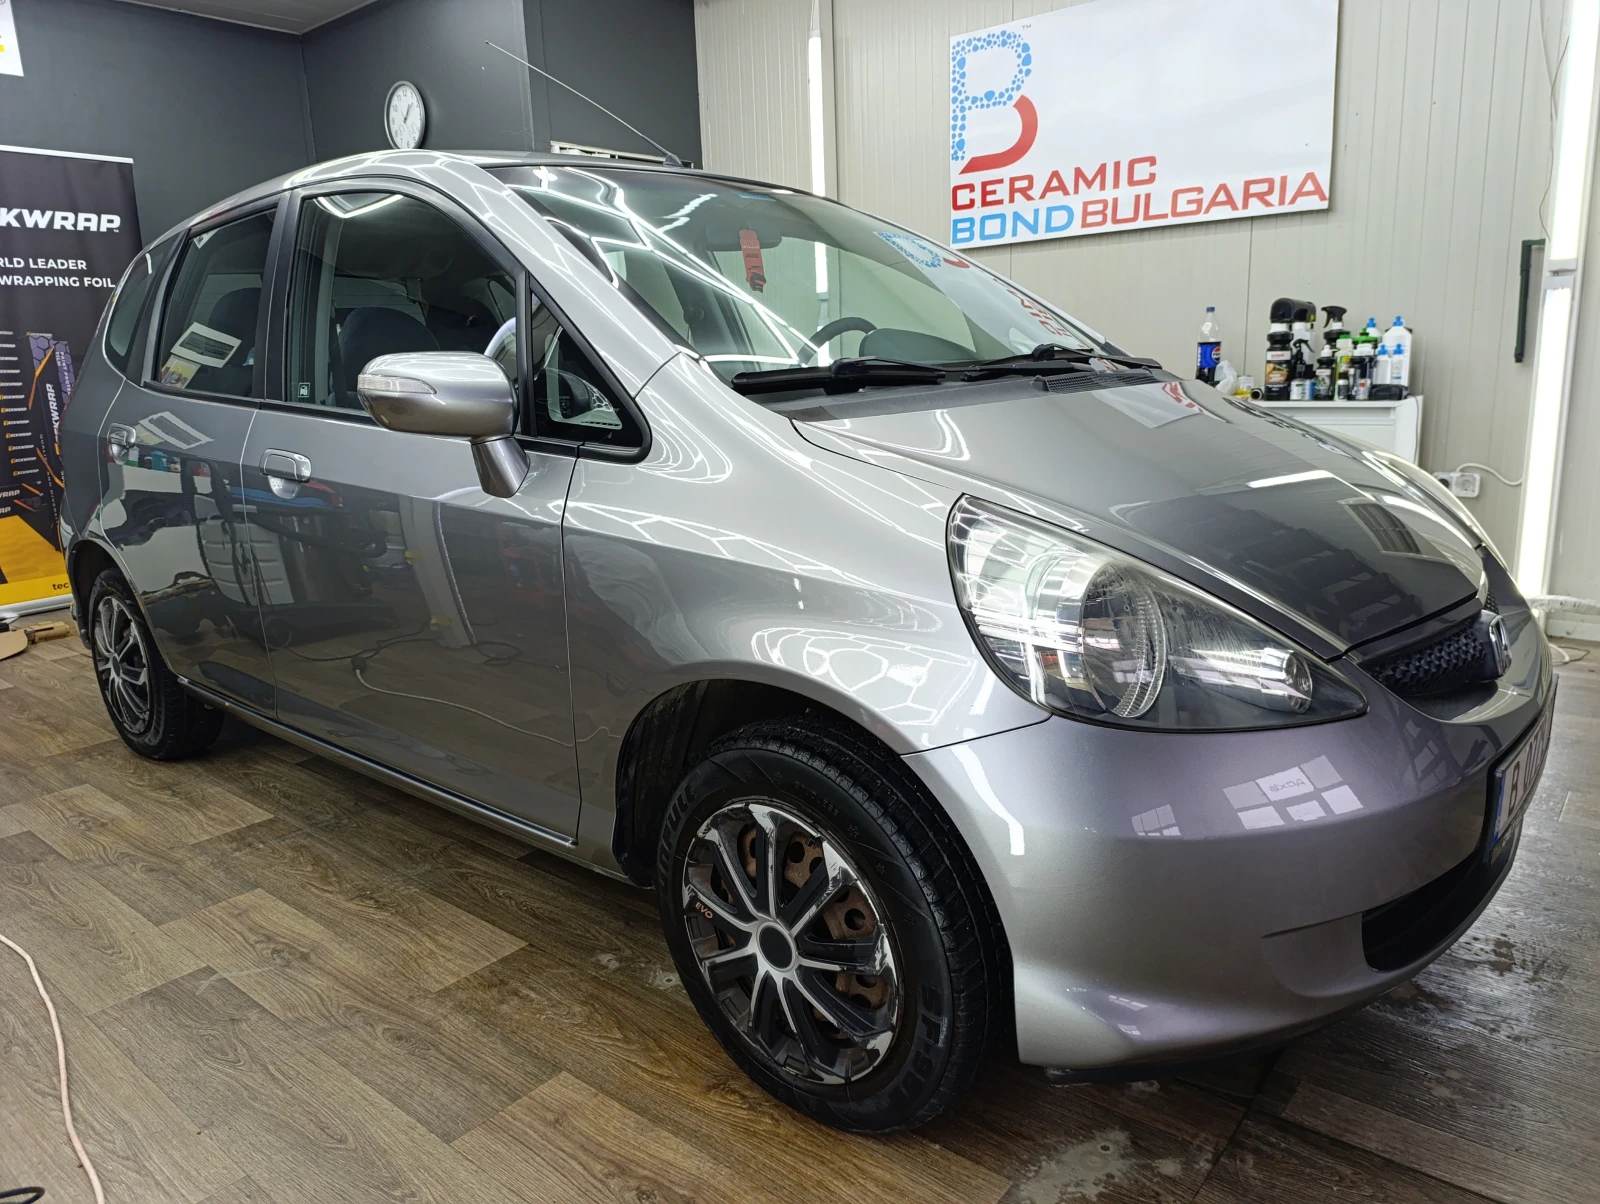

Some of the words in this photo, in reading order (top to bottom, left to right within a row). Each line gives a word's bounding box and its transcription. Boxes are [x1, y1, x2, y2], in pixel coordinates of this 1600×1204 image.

[952, 156, 1156, 211] CERAMIC
[952, 205, 1074, 244] BOND
[1081, 172, 1328, 228] BULGARIA
[0, 207, 121, 232] KWRAP
[29, 258, 87, 270] LEADER
[0, 275, 80, 287] WRAPPING
[84, 277, 116, 288] FOIL
[52, 582, 69, 590] tec
[1508, 761, 1519, 818] B
[695, 901, 713, 919] EVO
